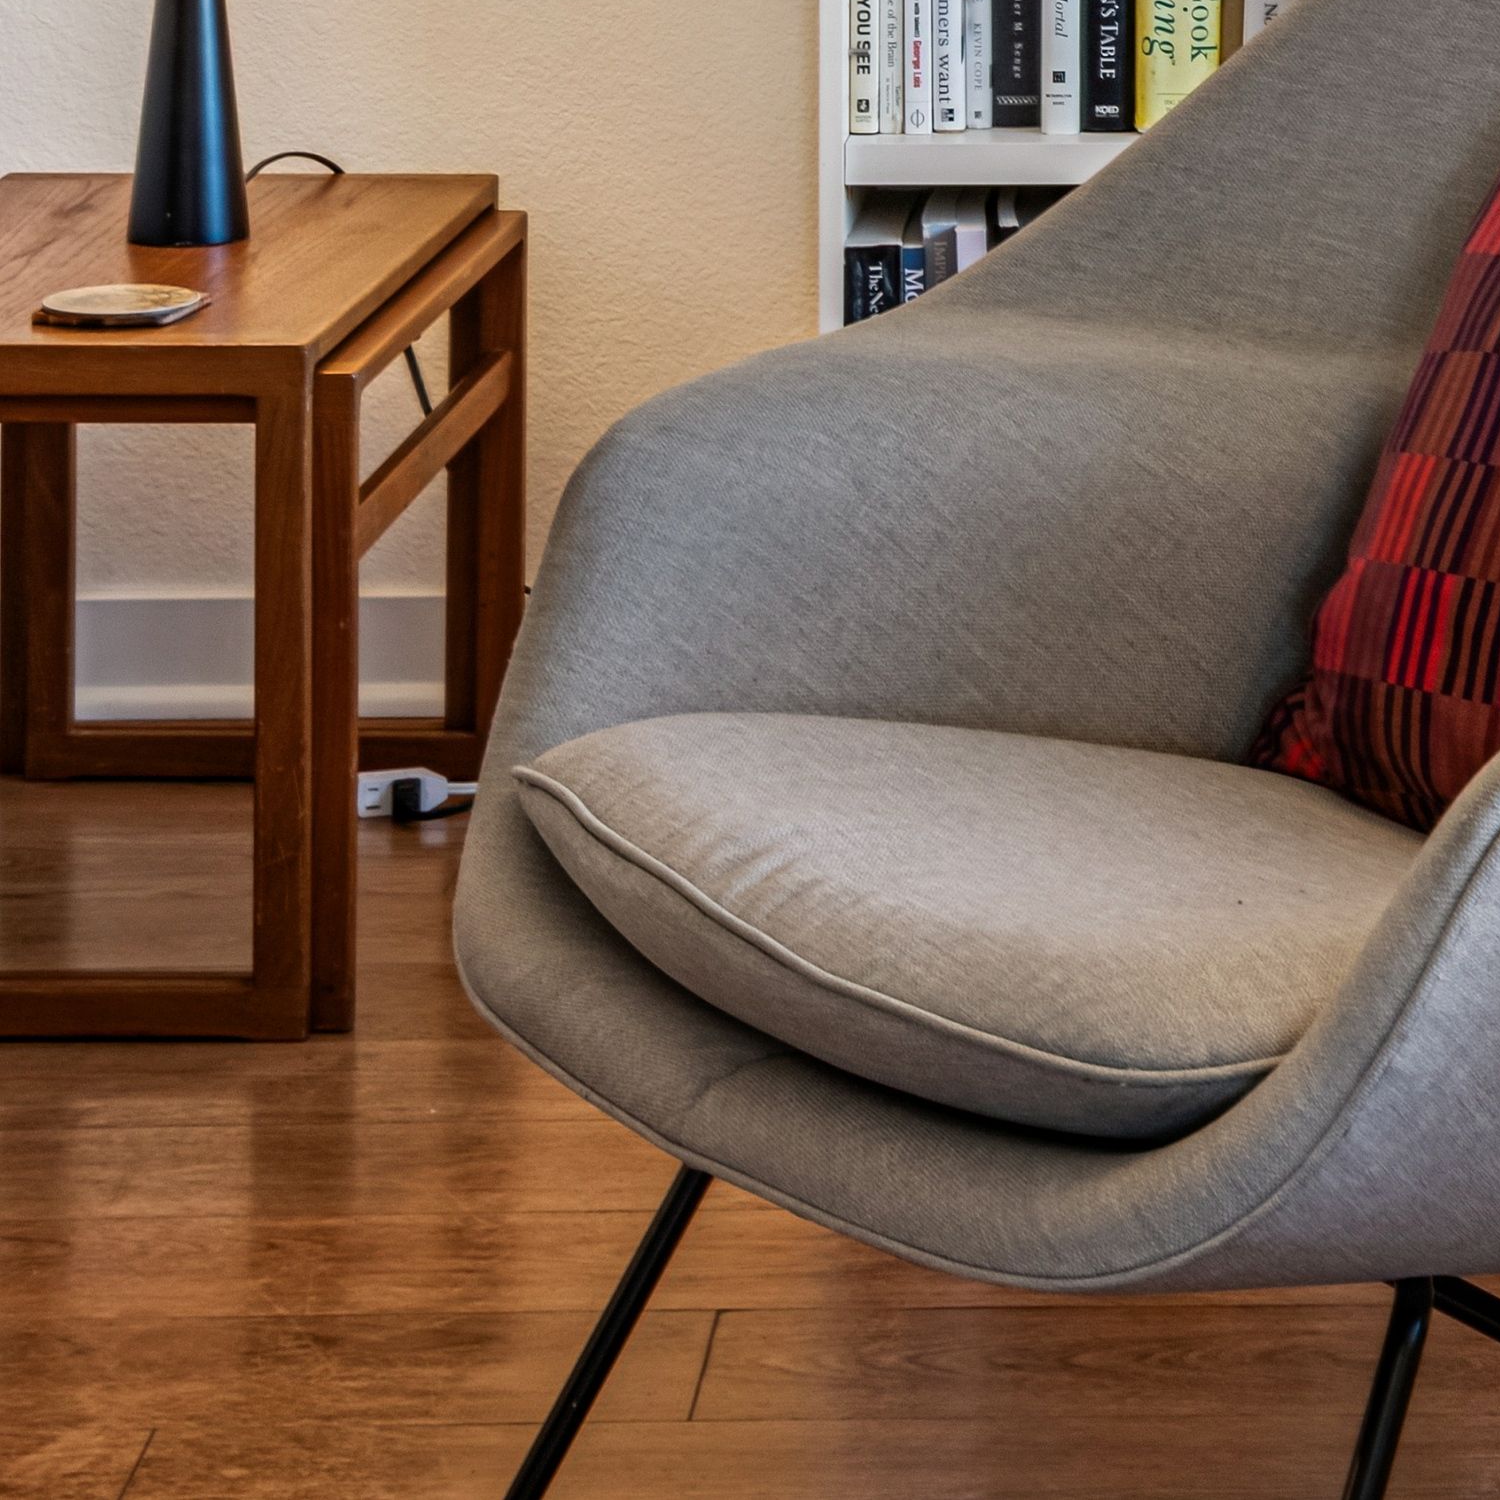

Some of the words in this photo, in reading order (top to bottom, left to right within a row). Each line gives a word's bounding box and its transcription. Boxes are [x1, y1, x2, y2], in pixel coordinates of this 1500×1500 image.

[857, 41, 870, 75] SEE
[1100, 22, 1118, 79] TABLE
[938, 54, 953, 103] want
